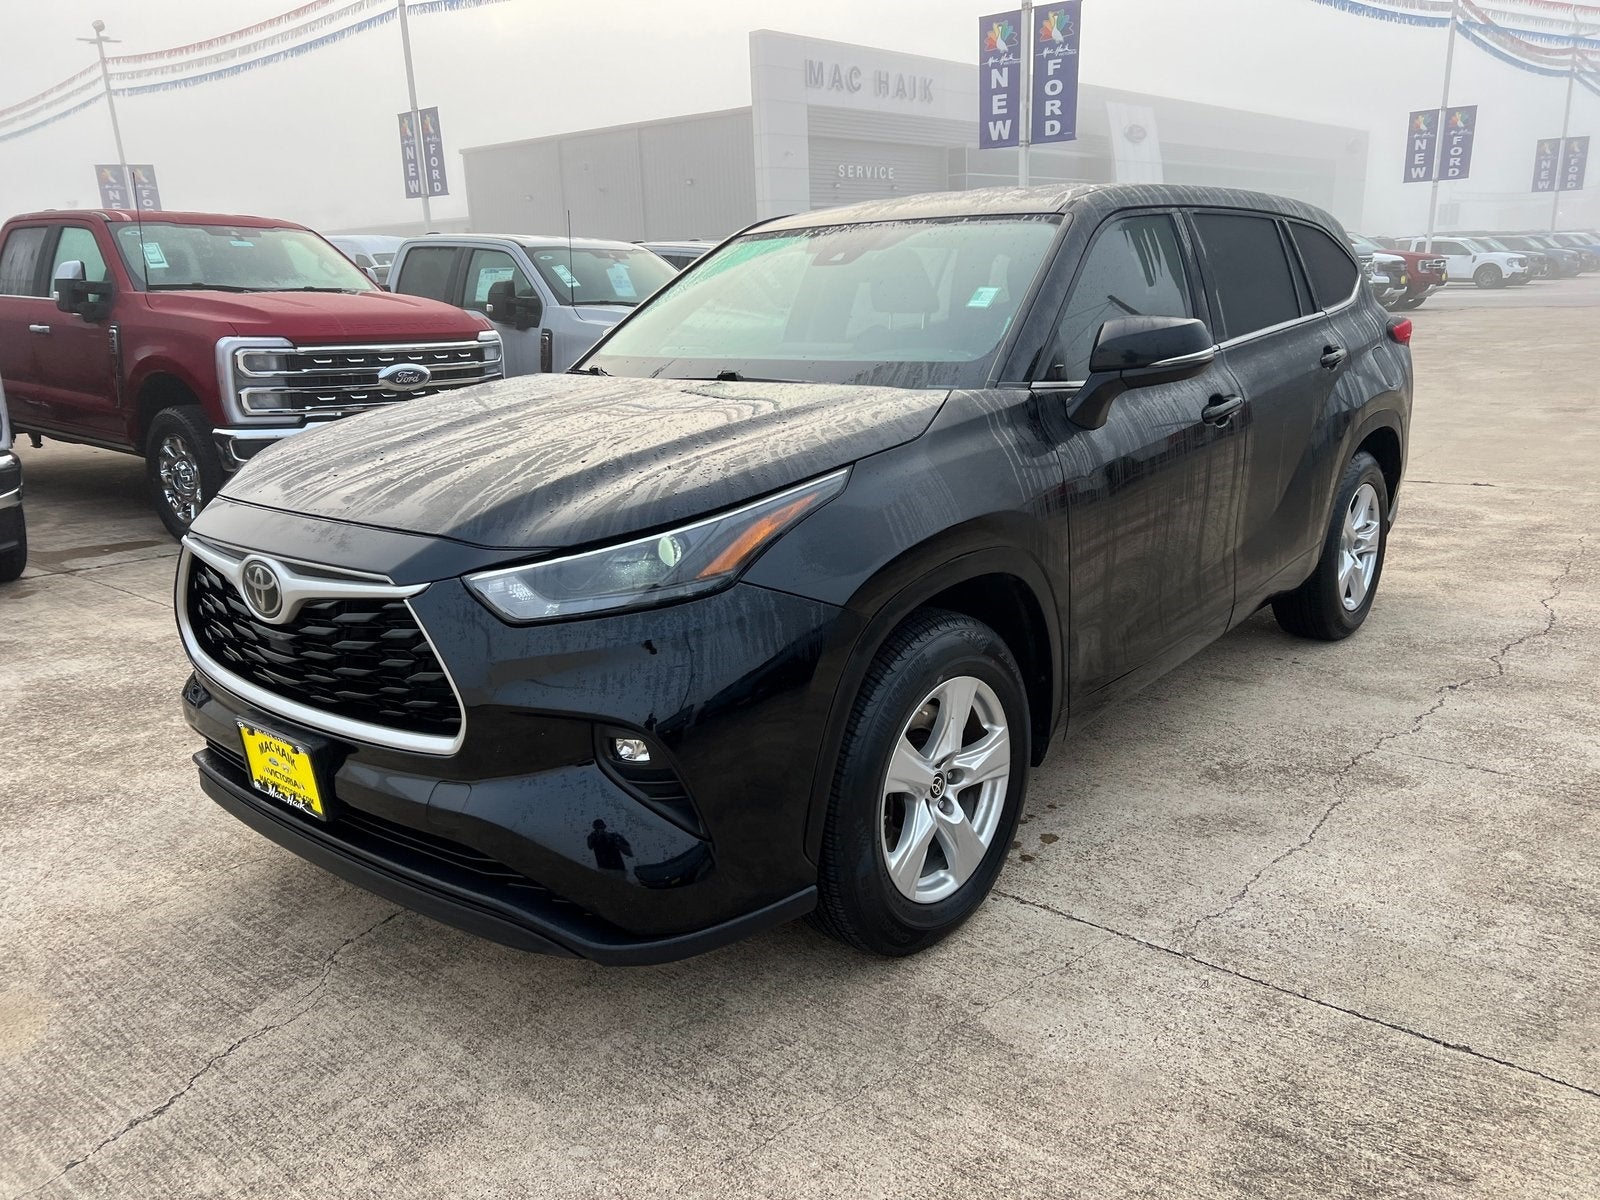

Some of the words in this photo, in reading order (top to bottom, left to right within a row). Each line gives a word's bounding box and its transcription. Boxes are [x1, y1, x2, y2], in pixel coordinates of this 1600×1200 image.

[804, 59, 862, 93] MAC
[875, 70, 934, 103] HAIK
[1044, 58, 1063, 136] FORD
[988, 67, 1012, 141] NEW
[406, 146, 419, 193] NEW
[429, 143, 442, 192] FORD
[838, 164, 895, 179] SERVICE
[1411, 139, 1427, 178] NEW
[1448, 135, 1463, 177] FORD
[1566, 158, 1578, 189] FORD
[1537, 160, 1551, 189] NEW
[108, 190, 121, 209] NE
[141, 189, 155, 211] FO
[395, 371, 420, 384] Ford
[268, 785, 284, 799] Mac
[286, 794, 306, 809] Haik
